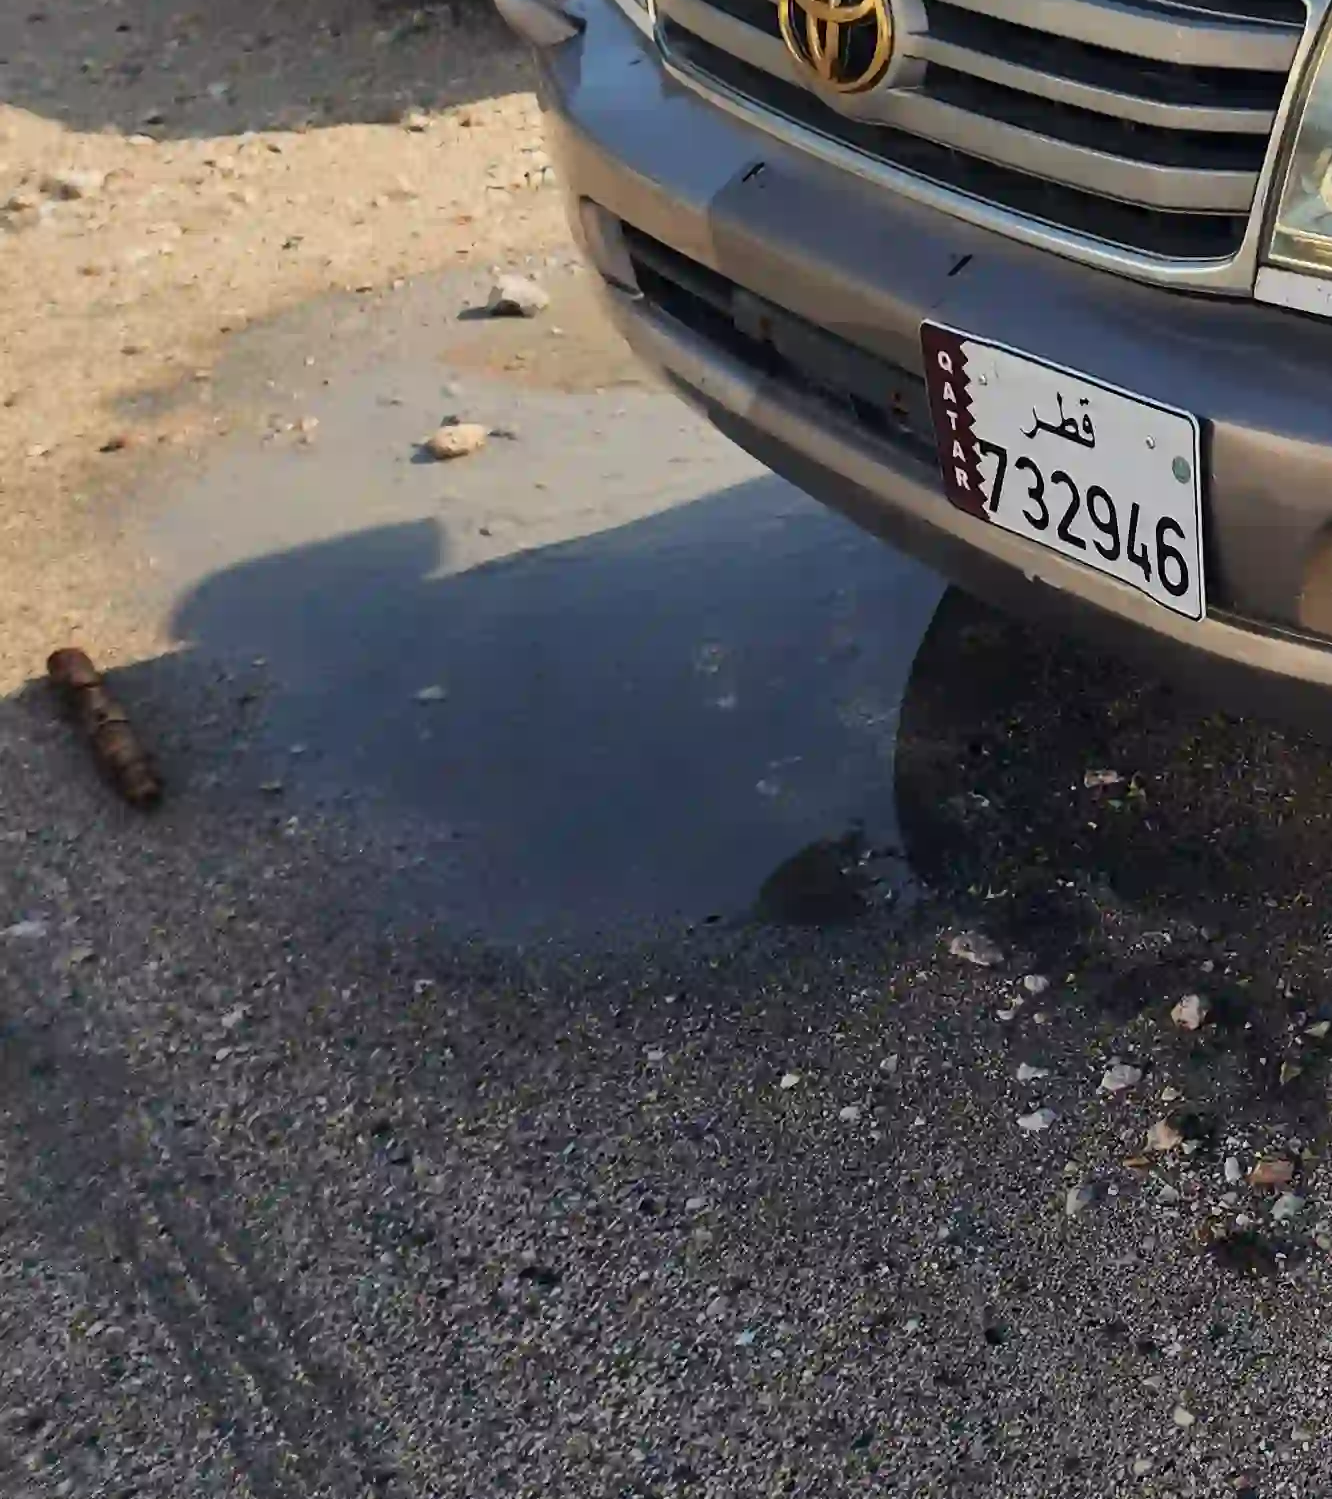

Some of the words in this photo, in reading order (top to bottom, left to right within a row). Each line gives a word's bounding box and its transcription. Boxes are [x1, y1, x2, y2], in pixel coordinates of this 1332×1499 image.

[937, 350, 971, 491] QATAR
[1019, 391, 1096, 449] قطر
[977, 437, 1190, 597] 732946
